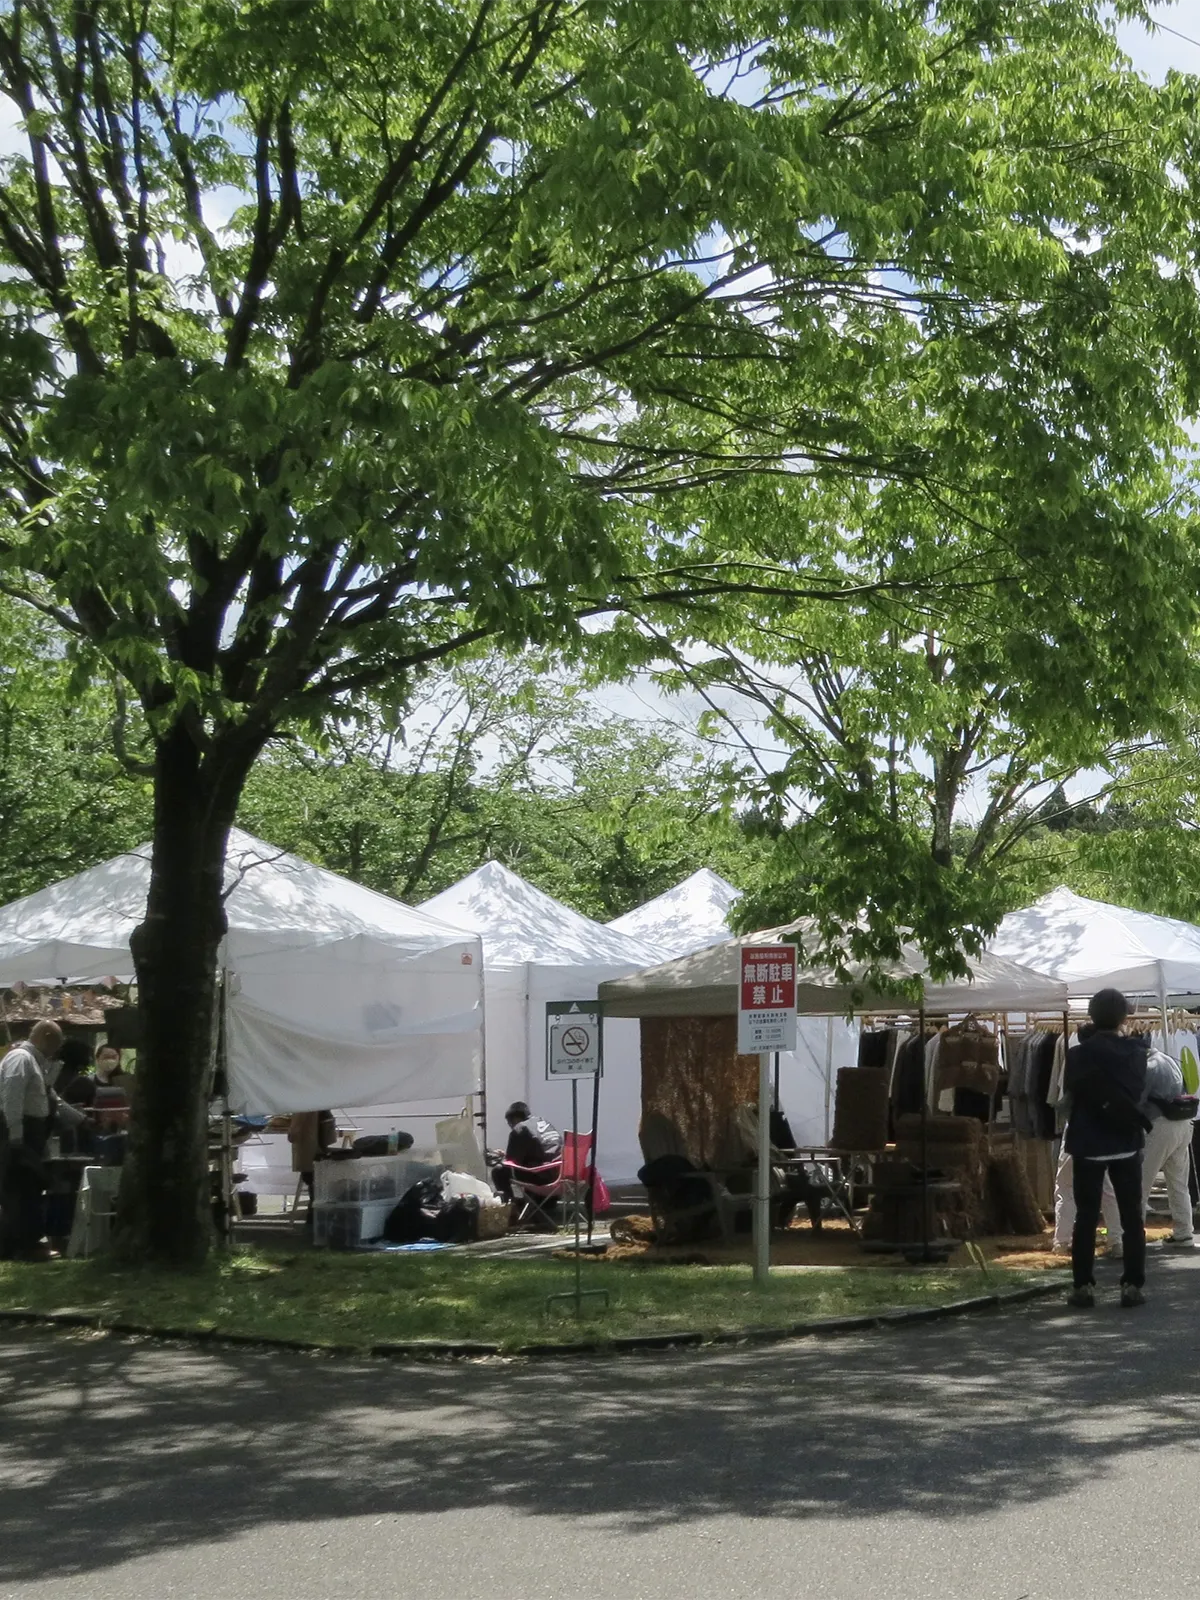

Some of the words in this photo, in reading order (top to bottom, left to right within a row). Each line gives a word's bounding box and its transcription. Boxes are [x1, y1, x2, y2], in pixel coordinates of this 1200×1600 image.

[744, 963, 793, 983] 無断駐車
[752, 985, 784, 1005] 禁止
